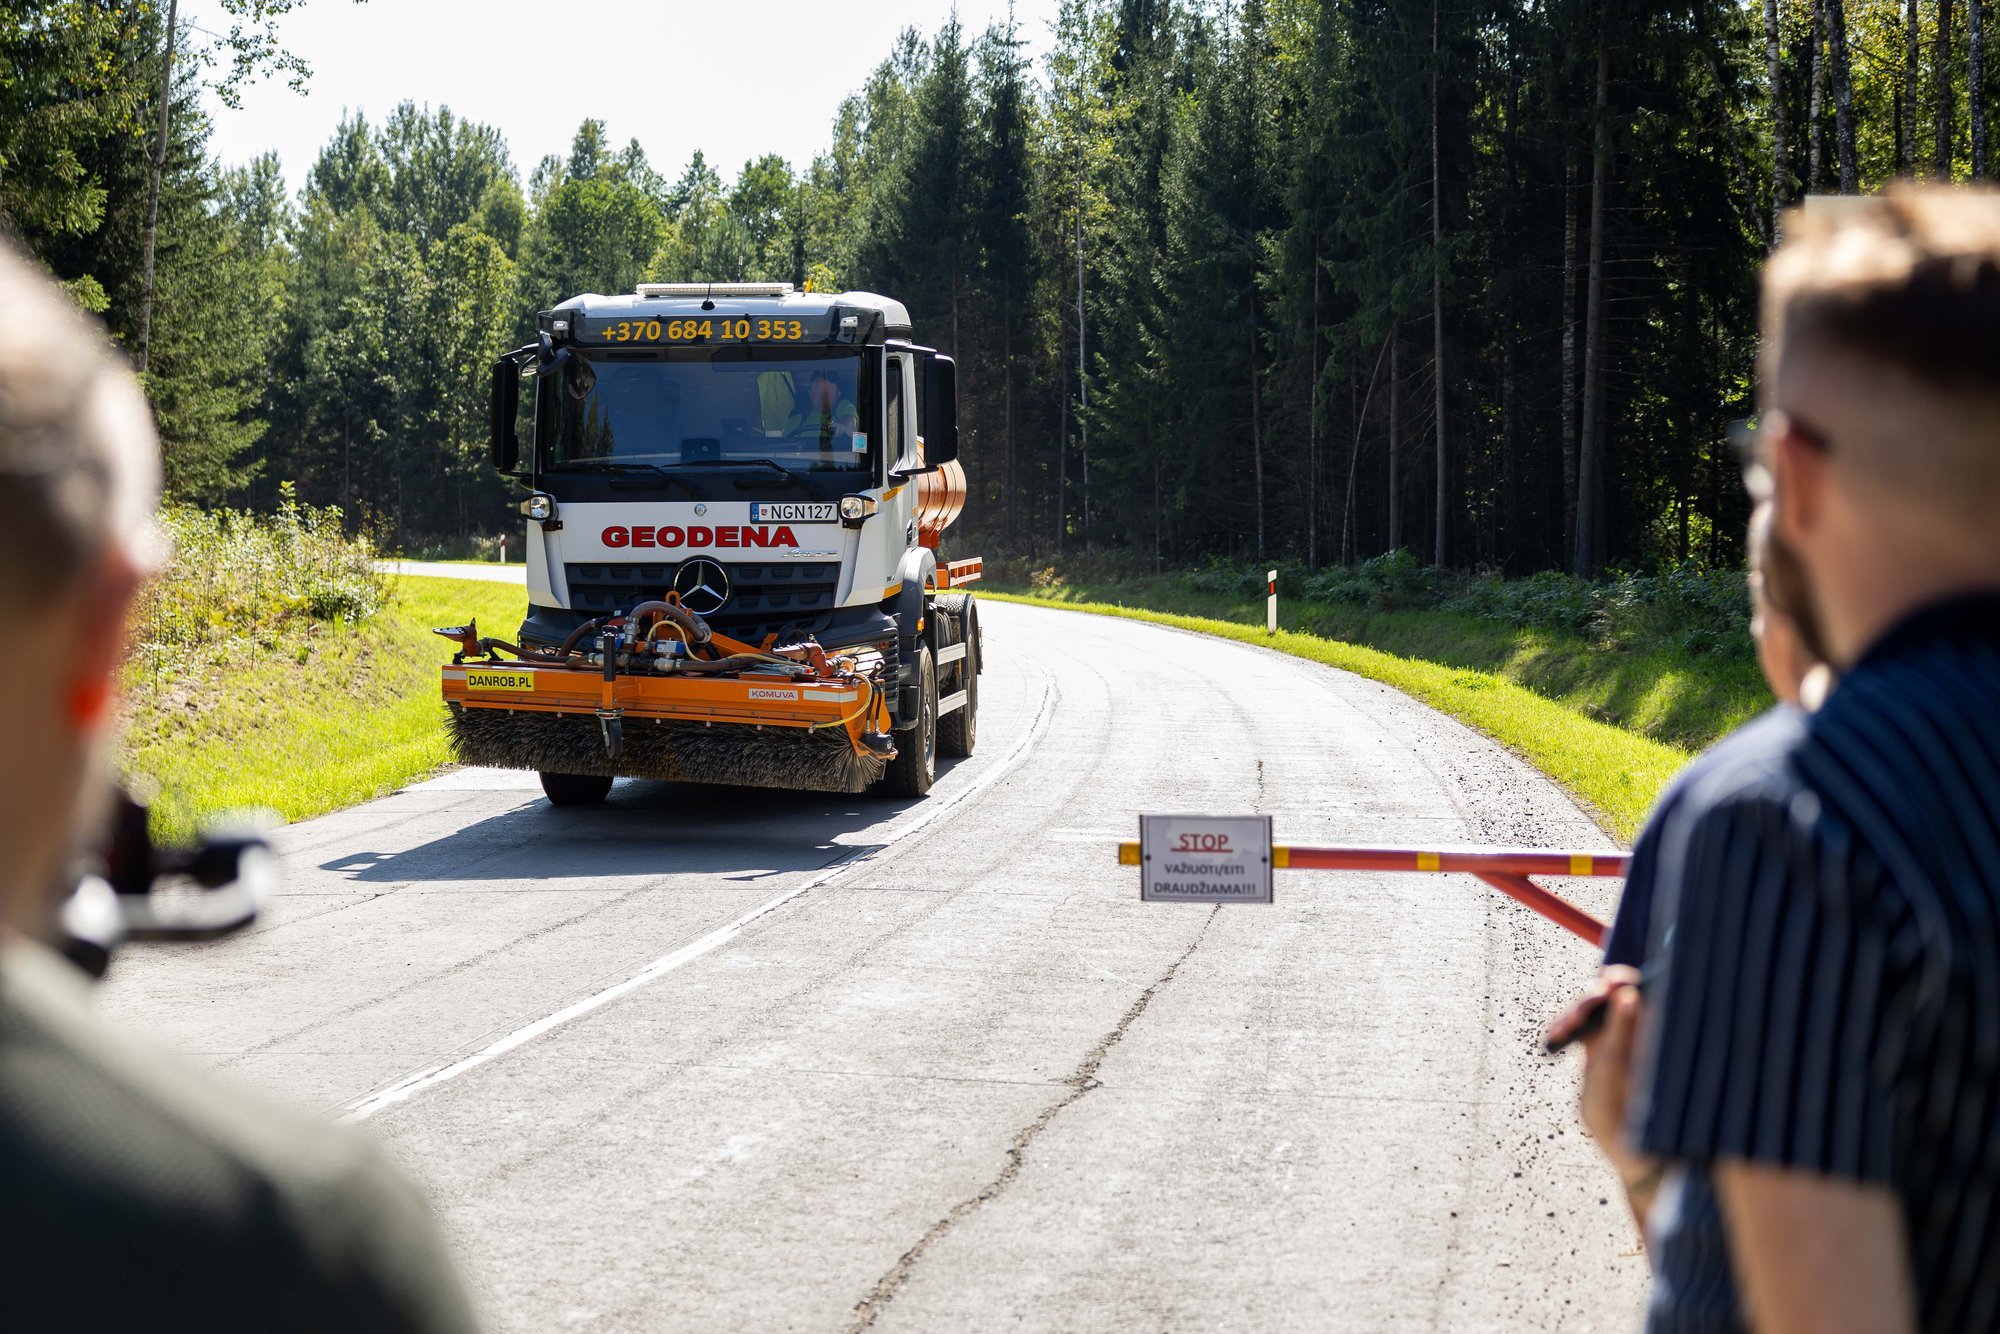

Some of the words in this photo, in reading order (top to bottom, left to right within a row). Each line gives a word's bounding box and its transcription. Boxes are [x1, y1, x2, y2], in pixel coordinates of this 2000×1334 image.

[602, 322, 661, 341] +370
[668, 320, 713, 340] 684
[721, 319, 750, 339] 10
[757, 320, 802, 340] 353
[771, 505, 833, 519] NGN127
[601, 526, 799, 548] GEODENA
[469, 675, 531, 688] DANROB.PL
[751, 690, 795, 699] KOMUVA
[1179, 833, 1229, 850] STOP
[1164, 863, 1245, 876] VAŽIUOTI/EITI
[1154, 881, 1256, 895] DRAUDŽIAMA!!!
